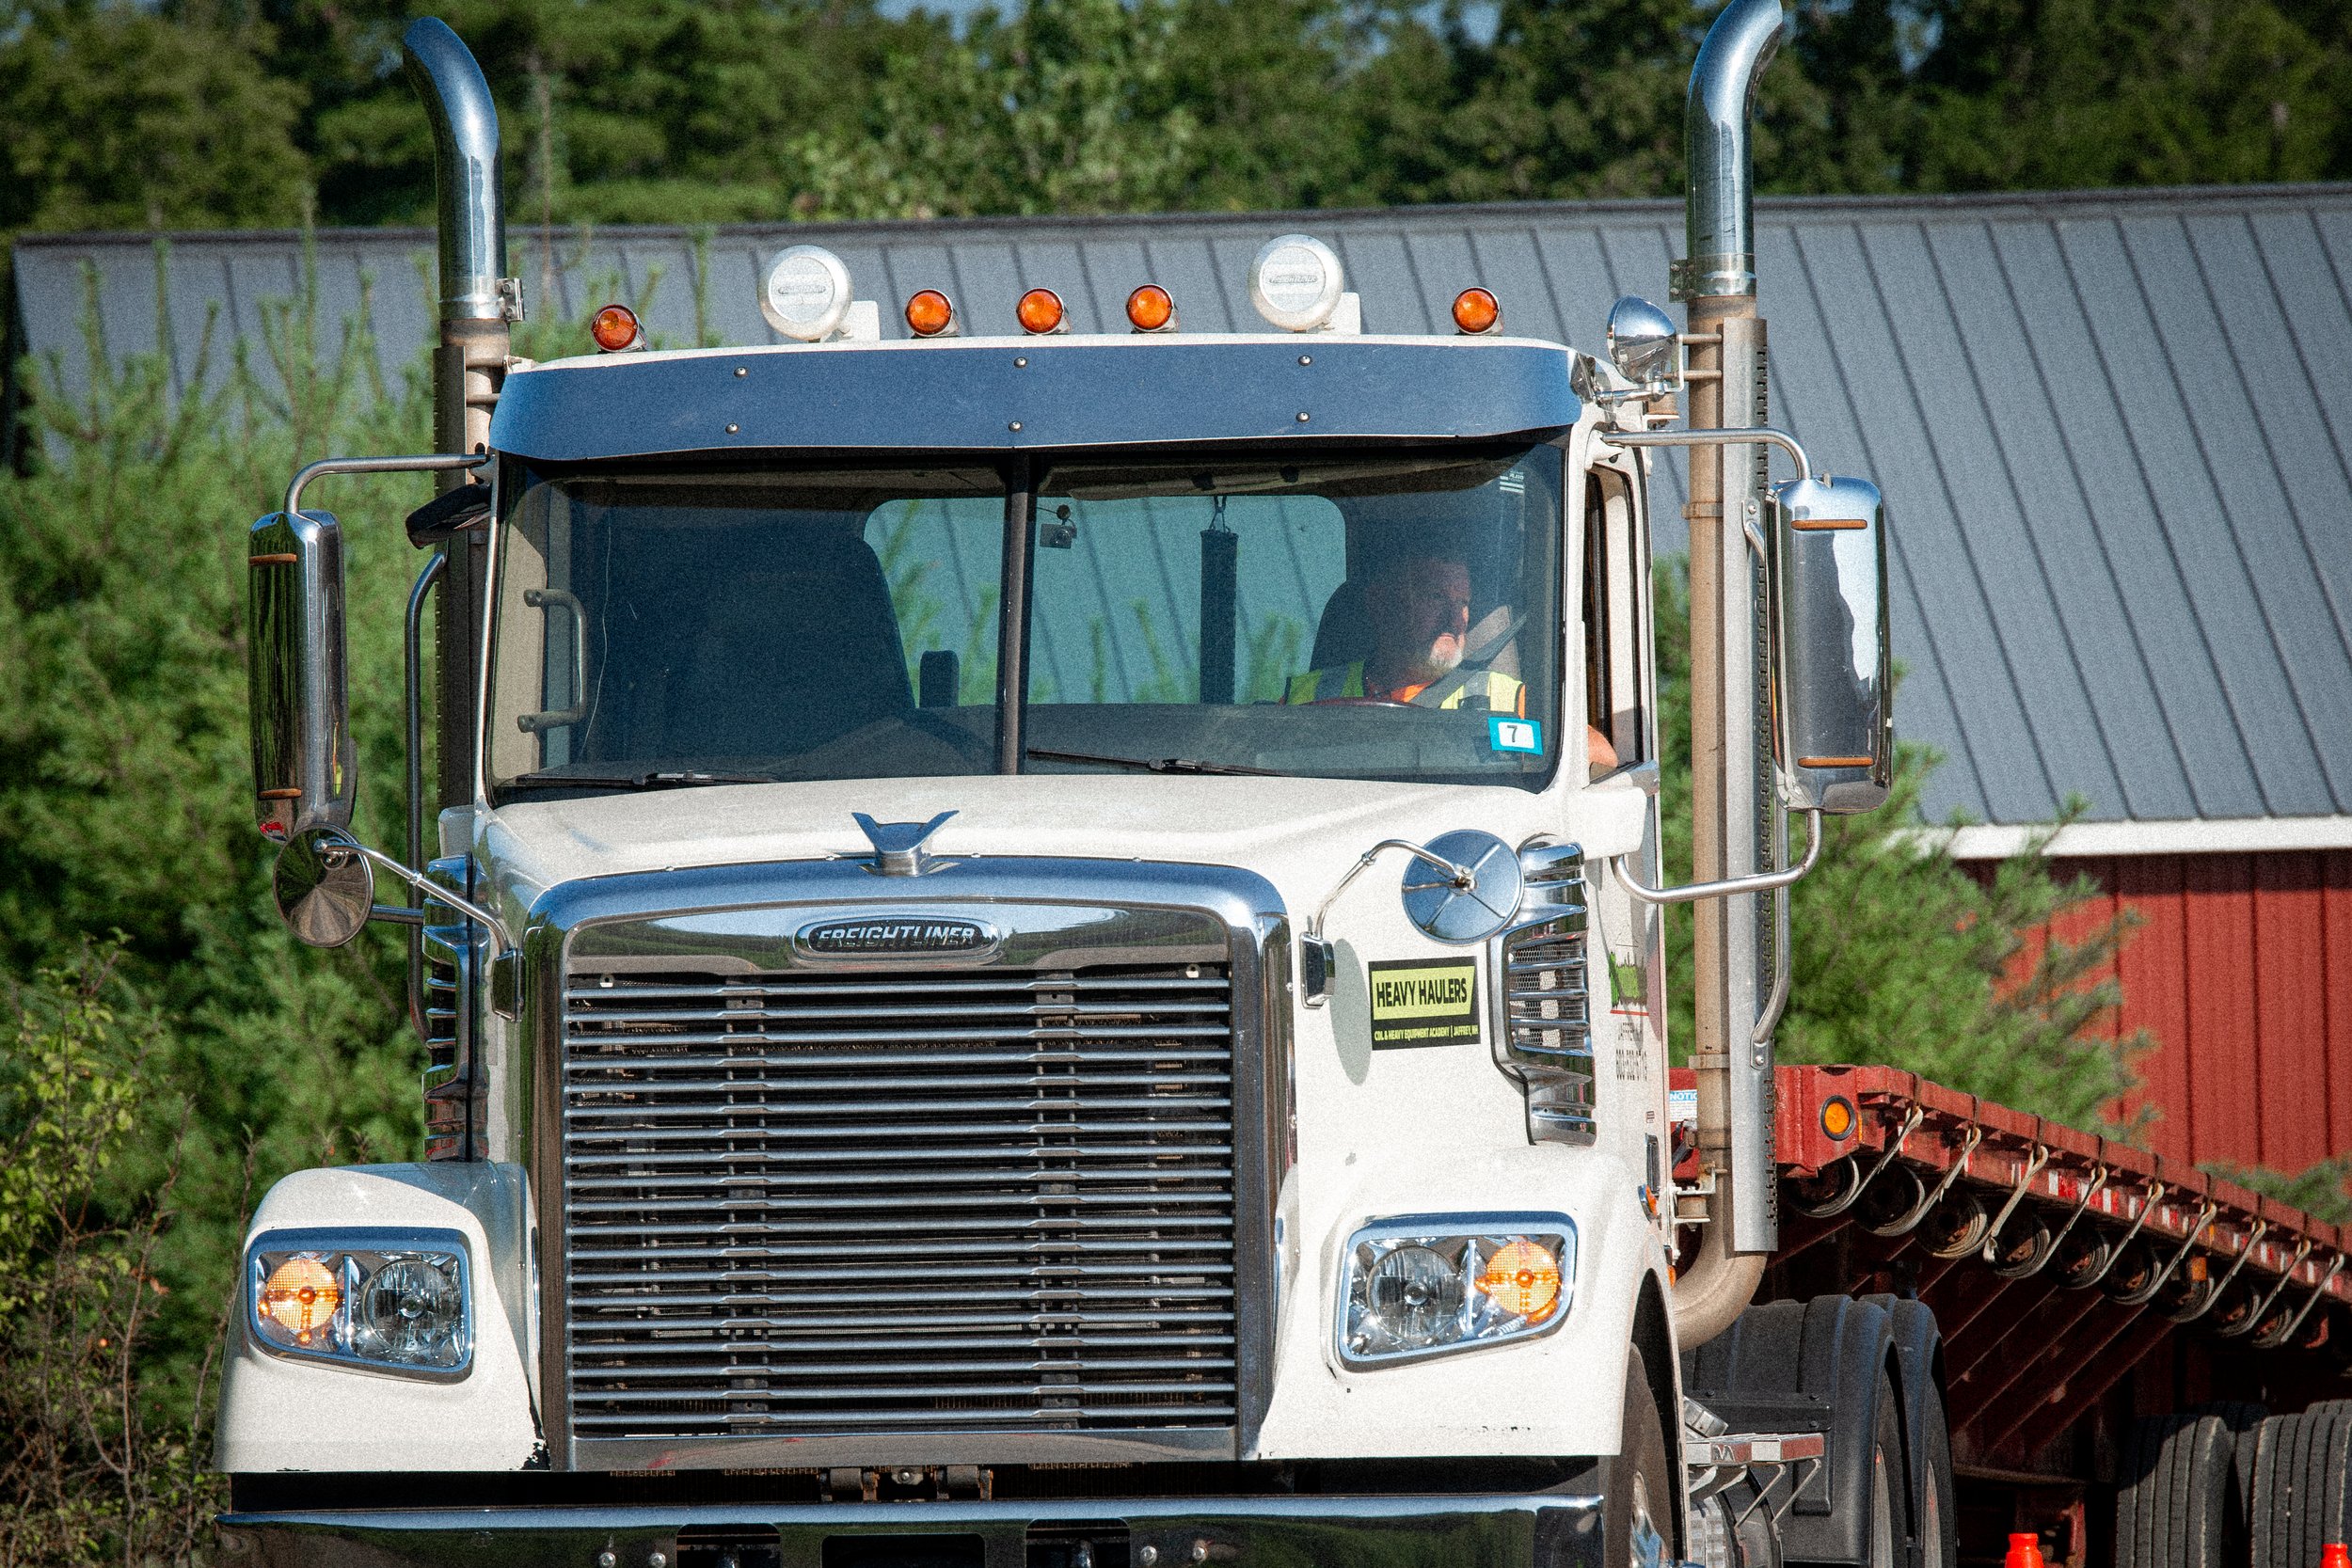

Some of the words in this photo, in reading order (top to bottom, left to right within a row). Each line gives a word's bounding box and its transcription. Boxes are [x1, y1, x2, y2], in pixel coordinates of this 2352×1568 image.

[1507, 724, 1518, 743] 7
[817, 925, 976, 949] FREIGHTLINER
[1376, 980, 1416, 1007] HEAVY
[1419, 977, 1468, 1006] HAULERS
[1404, 1027, 1429, 1041] EQUIPMENT
[1670, 1092, 1697, 1101] NOTIC
